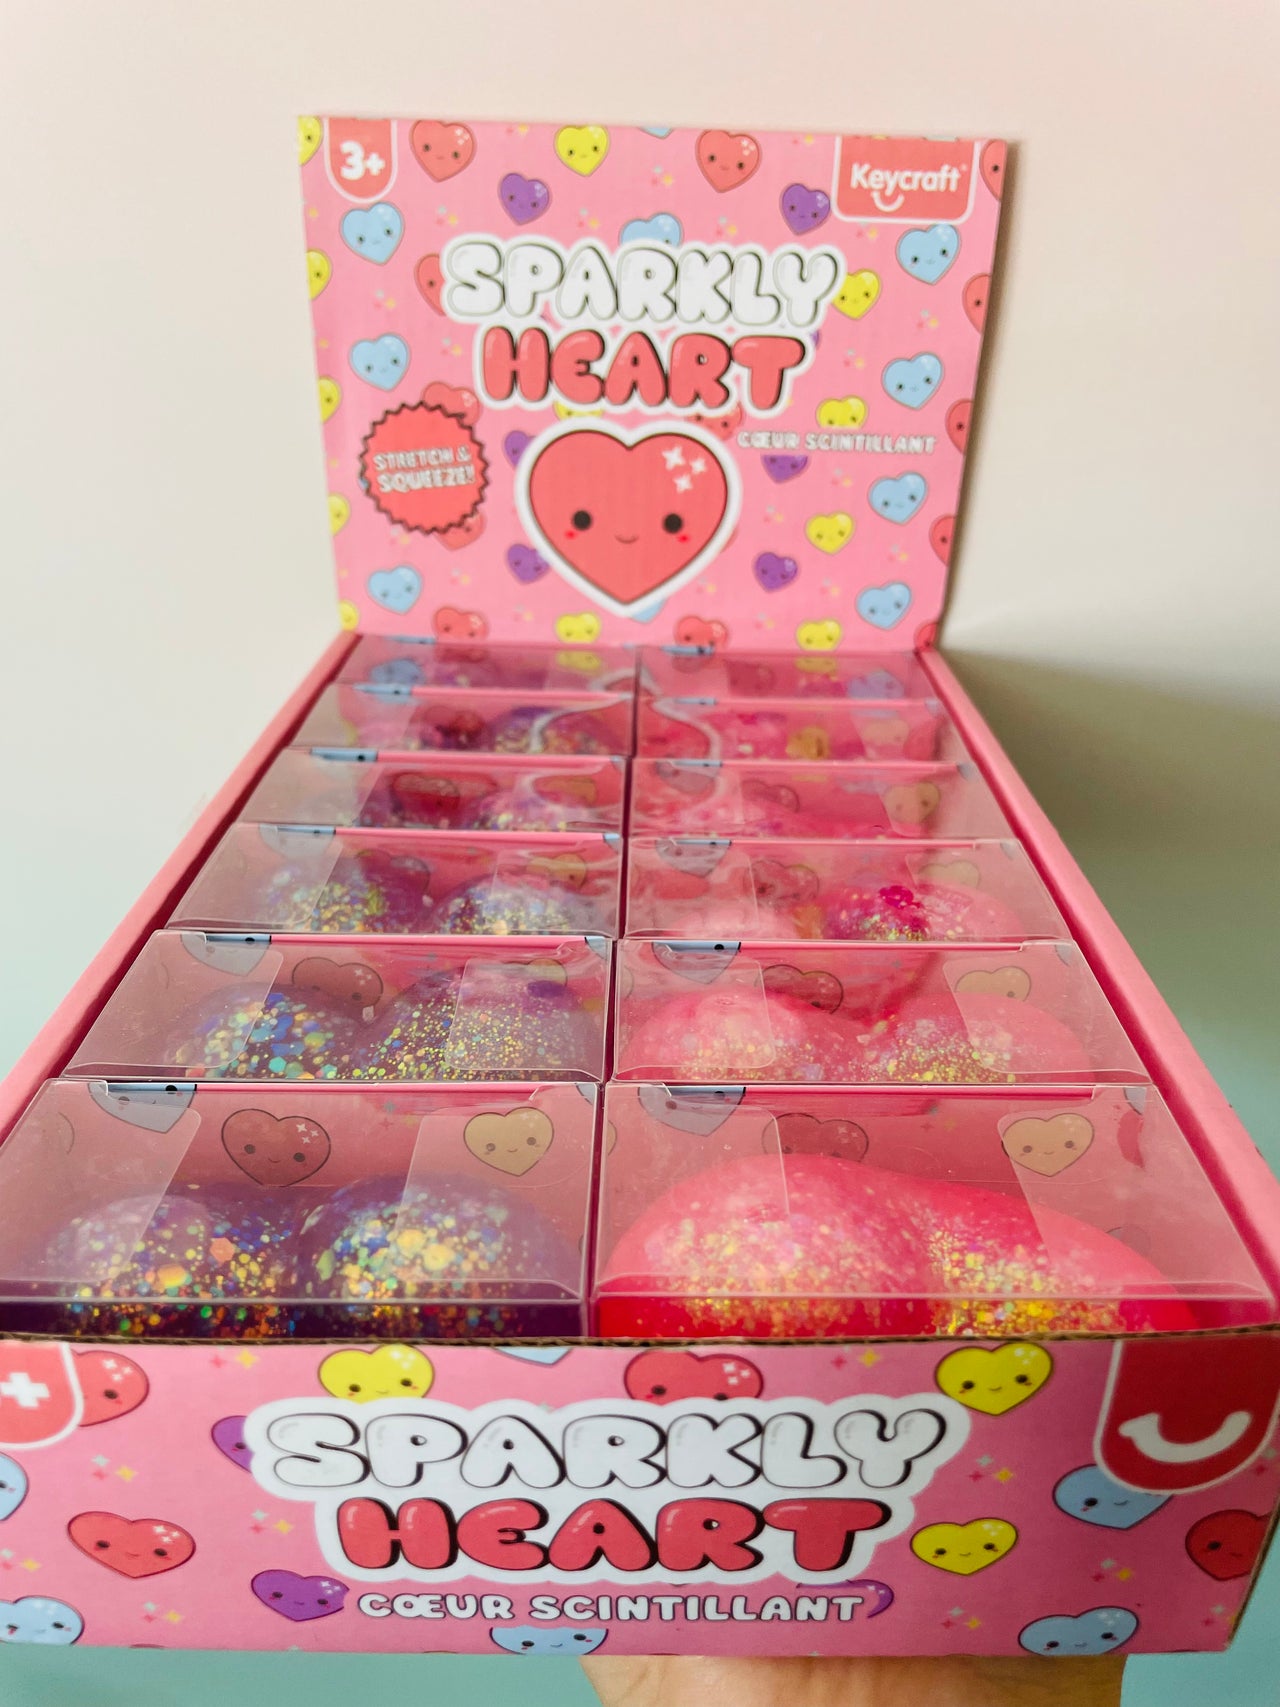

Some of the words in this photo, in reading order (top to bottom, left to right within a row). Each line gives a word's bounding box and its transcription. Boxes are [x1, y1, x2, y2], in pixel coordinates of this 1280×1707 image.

[340, 140, 386, 180] 3+
[850, 162, 960, 195] Keycraft
[449, 242, 838, 325] SPARKLY
[482, 326, 806, 409] HEART
[373, 448, 454, 471] STRETCH
[457, 445, 471, 462] &
[805, 432, 936, 454] SCINTILLANT
[377, 465, 476, 493] SQUEEZE!
[266, 1409, 946, 1490] SPARKLY
[337, 1497, 892, 1573] HEART
[529, 1593, 864, 1622] SCINTILLANT
